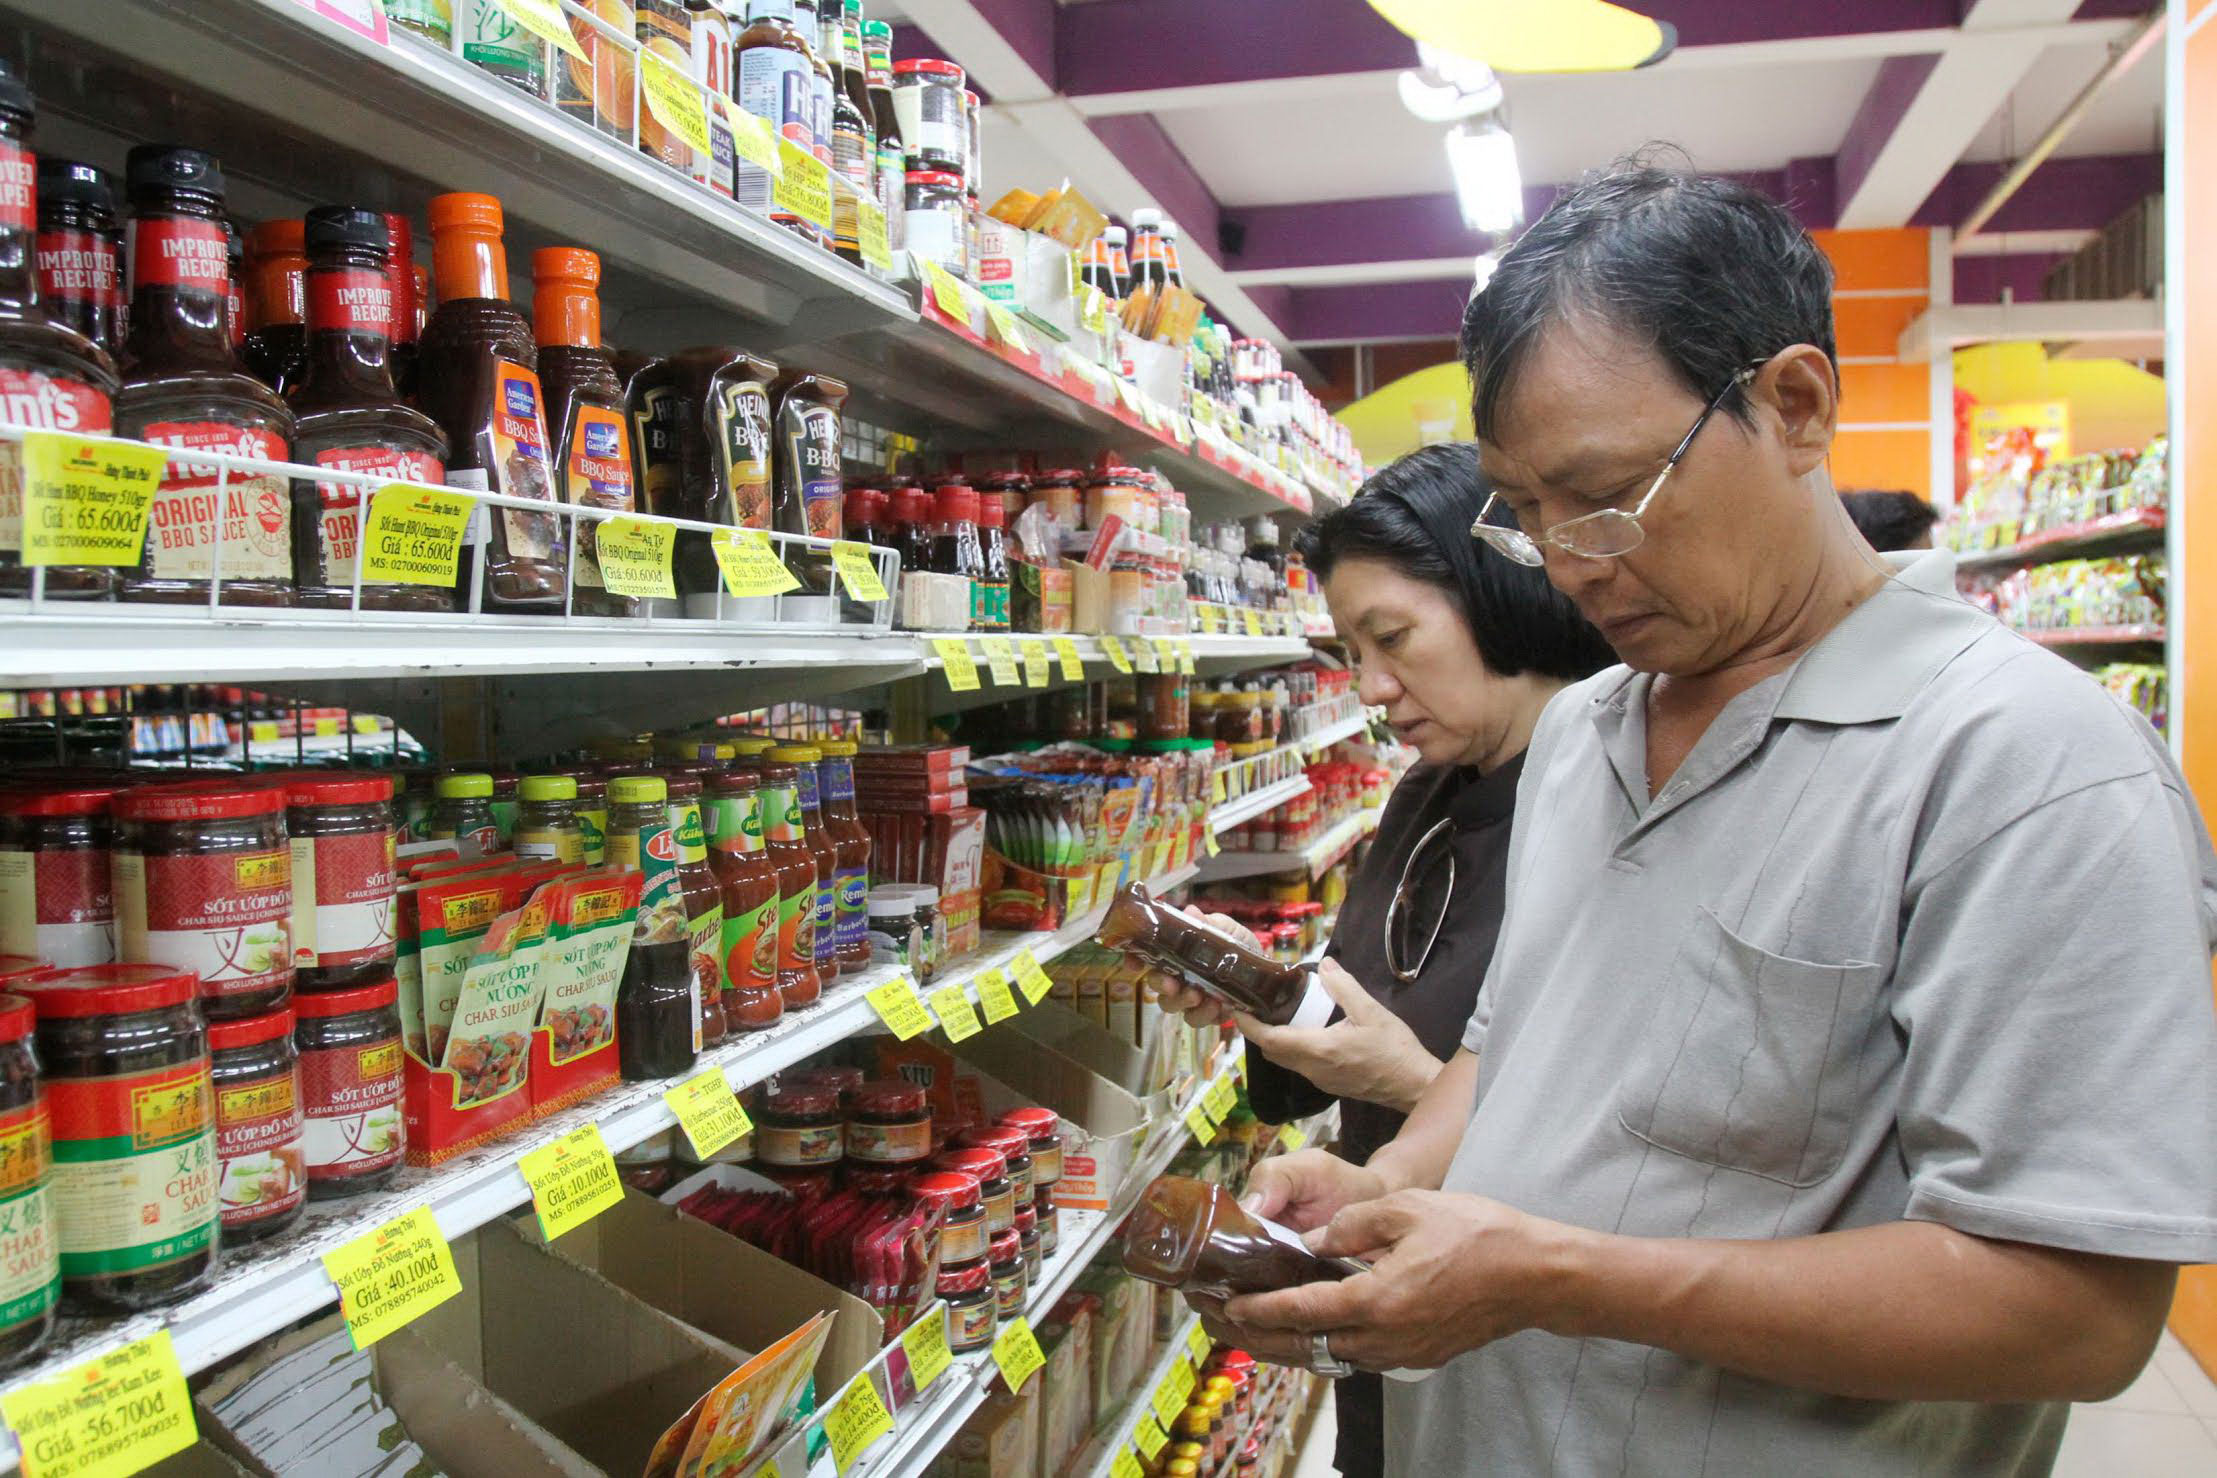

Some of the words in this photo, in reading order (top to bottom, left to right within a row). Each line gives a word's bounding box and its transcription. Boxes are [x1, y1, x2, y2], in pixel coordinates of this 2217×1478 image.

[162, 238, 229, 260] IMPROVE
[39, 251, 115, 273] IMPROVED
[178, 258, 229, 281] RECIPE
[53, 270, 112, 290] RECIPE!
[337, 287, 392, 306] IMPROVE
[352, 305, 392, 323] RECIPE
[504, 417, 529, 443] BBQ
[808, 420, 840, 445] HEZ
[581, 458, 606, 481] BBQ
[64, 485, 87, 504] BBQ
[153, 490, 249, 529] ORIGIAL
[76, 509, 142, 533] 65.600đ
[161, 526, 196, 549] BBQ
[381, 534, 401, 555] Giá
[411, 539, 454, 562] 65.600đ
[608, 543, 624, 562] BBQ
[624, 544, 647, 564] Original
[370, 557, 389, 570] MS:
[390, 558, 453, 576] 027000609019
[203, 895, 238, 915] SỐT
[841, 887, 867, 903] Remi
[443, 956, 468, 976] SỐT
[556, 984, 586, 998] CHAR
[439, 996, 458, 1013] CH
[464, 1008, 497, 1026] CHAR
[502, 1004, 519, 1019] SIU
[331, 1086, 359, 1105] SỐT
[218, 1140, 243, 1156] AUCE
[165, 1168, 211, 1198] CHAR
[182, 1184, 219, 1214] SAUC
[547, 1183, 567, 1207] Giá
[4, 1227, 43, 1257] HAR
[338, 1275, 353, 1291] Sốt
[411, 1236, 433, 1254] 240g
[355, 1281, 382, 1309] Giá
[350, 1312, 374, 1331] MS:
[34, 1428, 75, 1464] Giá
